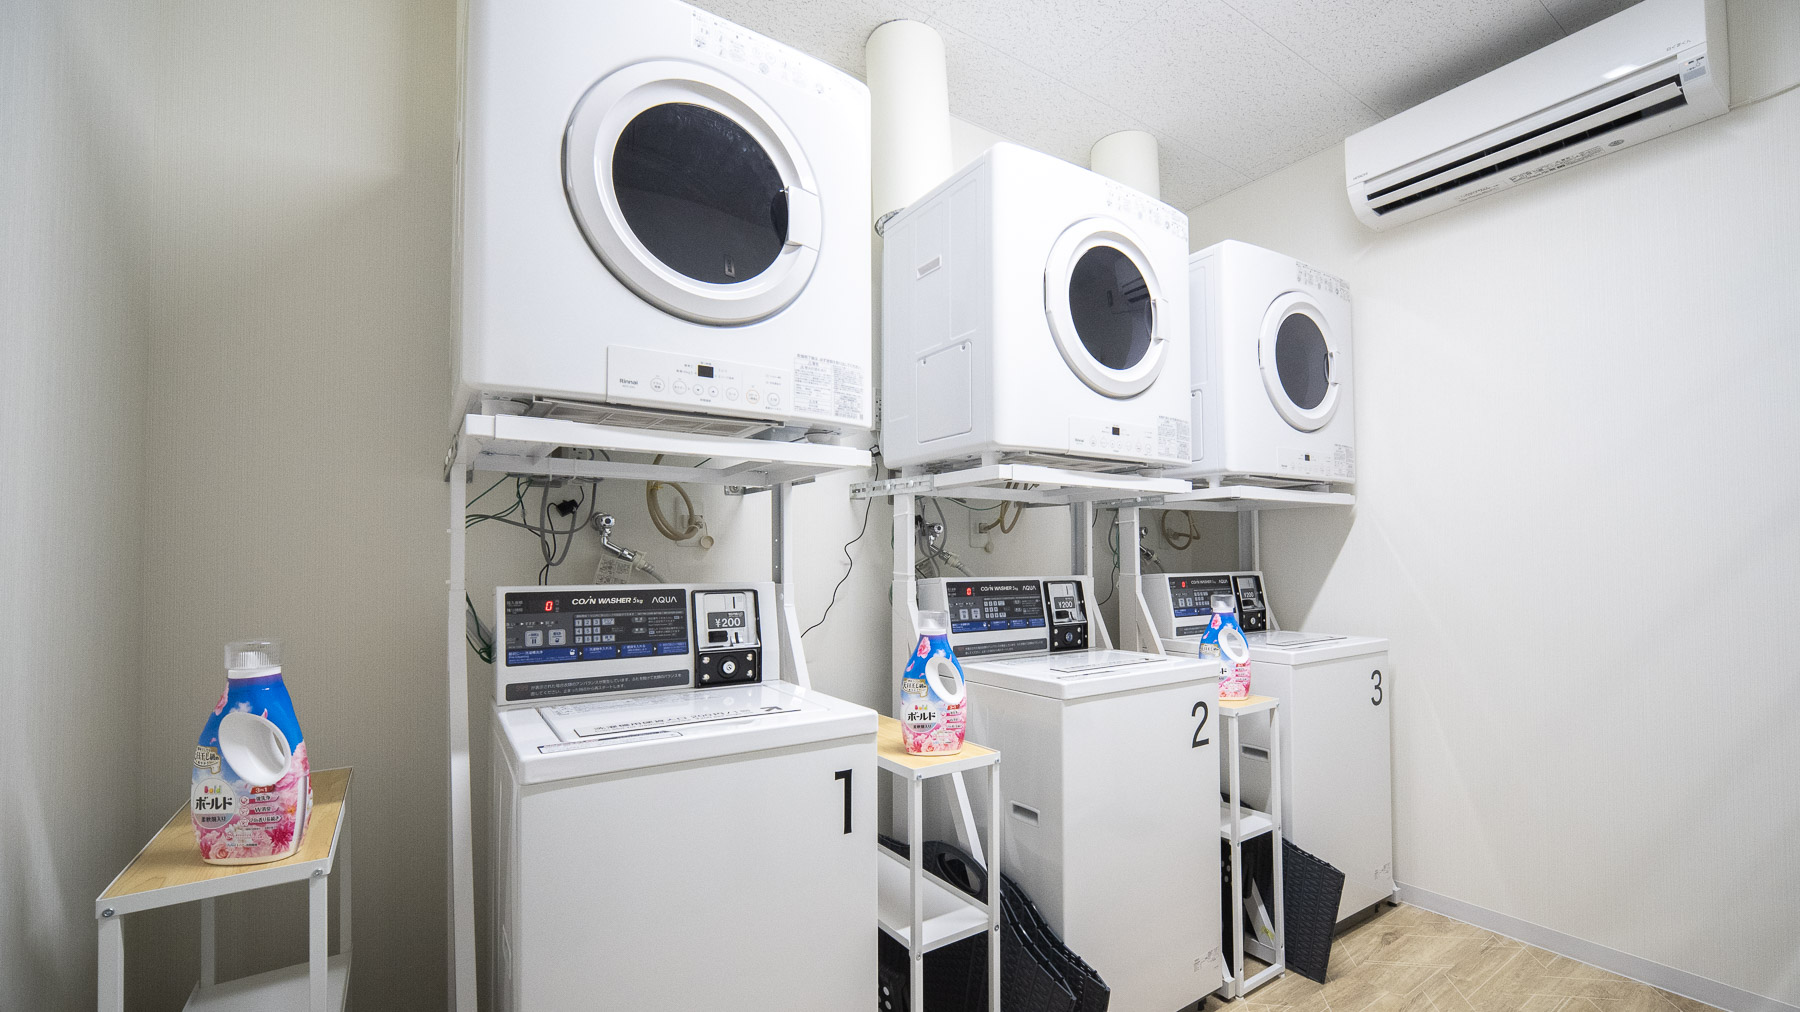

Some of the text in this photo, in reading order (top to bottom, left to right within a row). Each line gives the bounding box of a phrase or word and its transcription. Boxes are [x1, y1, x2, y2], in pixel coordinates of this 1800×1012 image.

[598, 597, 632, 605] WASHER
[632, 597, 644, 605] 5kg
[651, 596, 678, 604] AQUA
[1057, 601, 1073, 609] ¥200
[545, 600, 554, 612] 0
[714, 617, 741, 628] ¥200
[1370, 669, 1383, 706] 3
[907, 711, 936, 721] ボールド
[1191, 700, 1210, 749] 2
[195, 796, 233, 811] ボールド
[834, 768, 853, 835] 1
